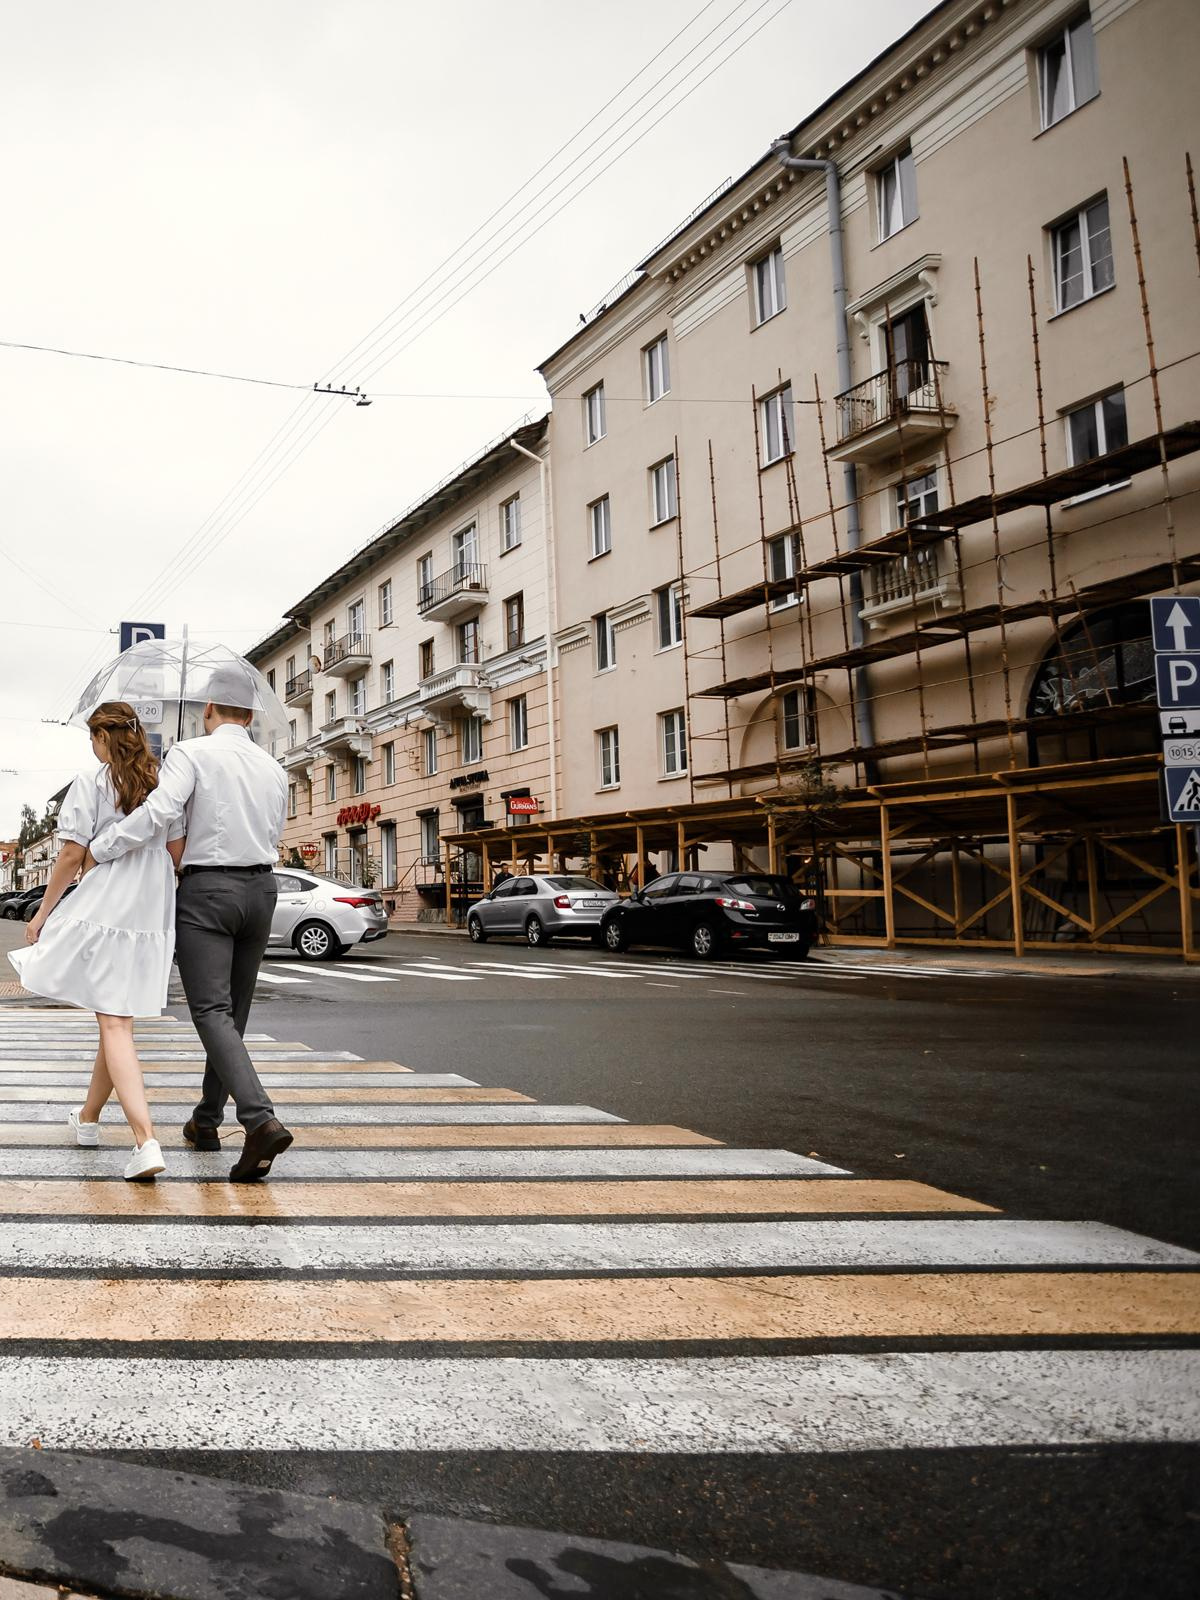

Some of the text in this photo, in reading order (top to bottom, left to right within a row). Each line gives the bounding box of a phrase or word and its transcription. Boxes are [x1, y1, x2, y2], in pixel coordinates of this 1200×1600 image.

[1169, 660, 1198, 702] P
[145, 706, 157, 715] 20
[1171, 749, 1181, 757] 10
[1182, 747, 1194, 756] 15
